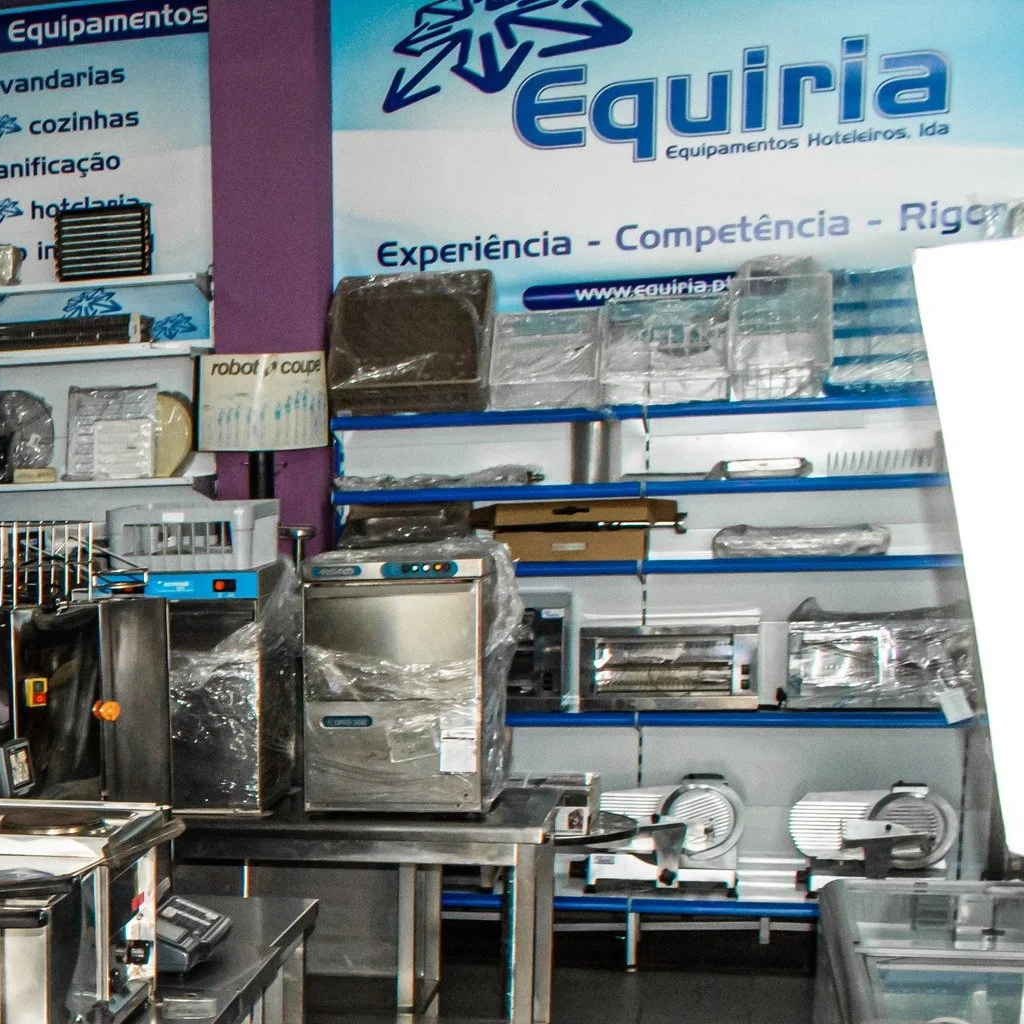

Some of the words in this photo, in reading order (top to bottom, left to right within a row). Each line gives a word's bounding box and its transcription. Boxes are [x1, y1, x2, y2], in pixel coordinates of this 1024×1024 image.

[8, 5, 209, 46] Equipamentos
[512, 34, 952, 163] Equiria
[29, 109, 140, 135] cozinhas
[665, 135, 799, 161] Equipamentos
[377, 229, 572, 270] Experiência
[615, 210, 850, 253] Competência
[211, 358, 260, 376] robot
[280, 357, 322, 377] coupe
